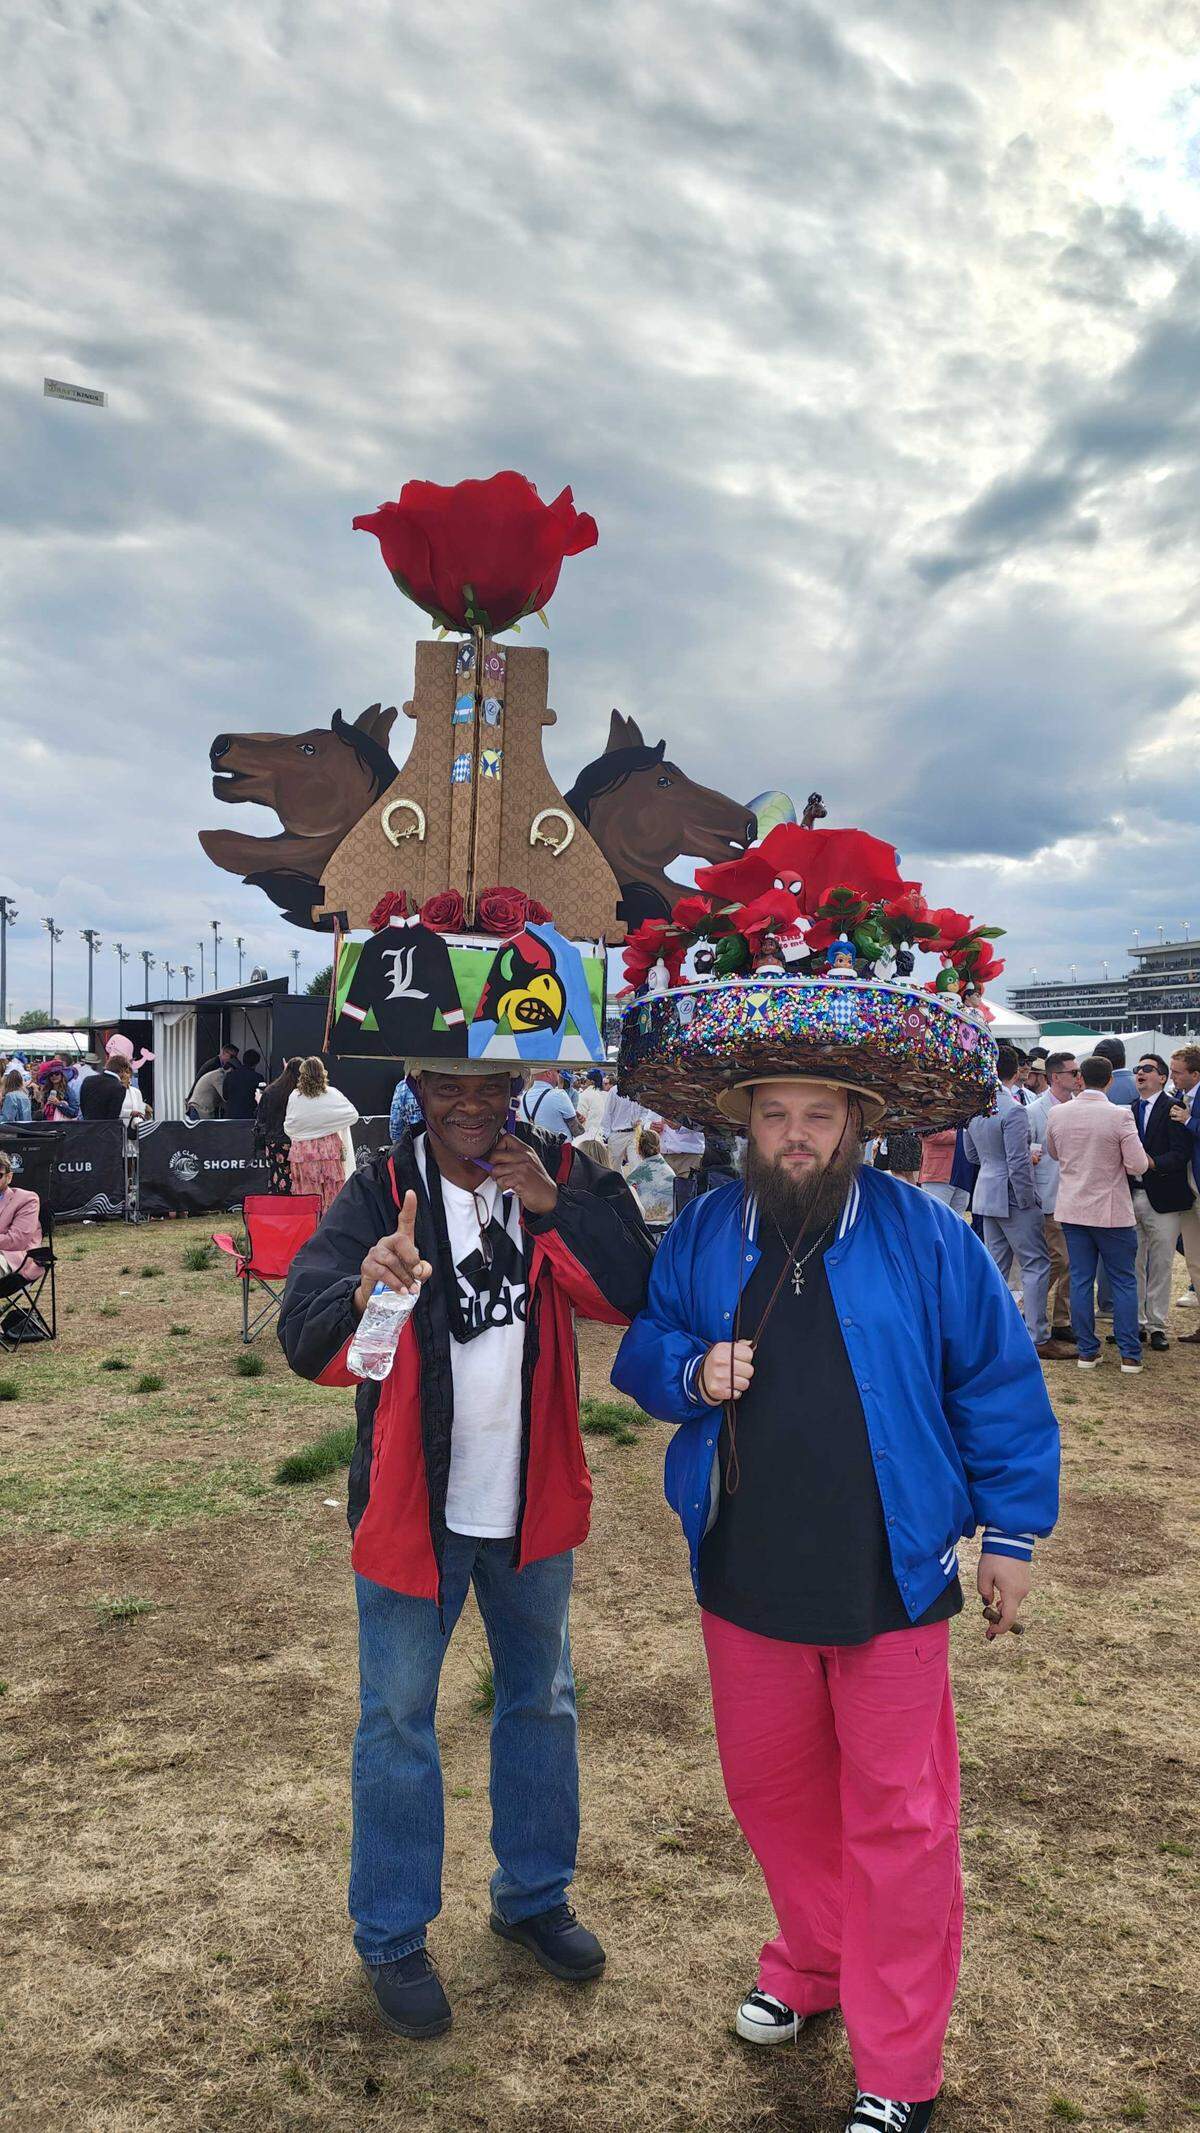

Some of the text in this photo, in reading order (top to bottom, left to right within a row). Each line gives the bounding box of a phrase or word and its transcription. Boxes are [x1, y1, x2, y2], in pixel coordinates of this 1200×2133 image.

[381, 945, 429, 1000] L
[169, 1150, 182, 1169] WHITE
[203, 1159, 273, 1170] SHORE CLU
[58, 1162, 93, 1173] CLUB
